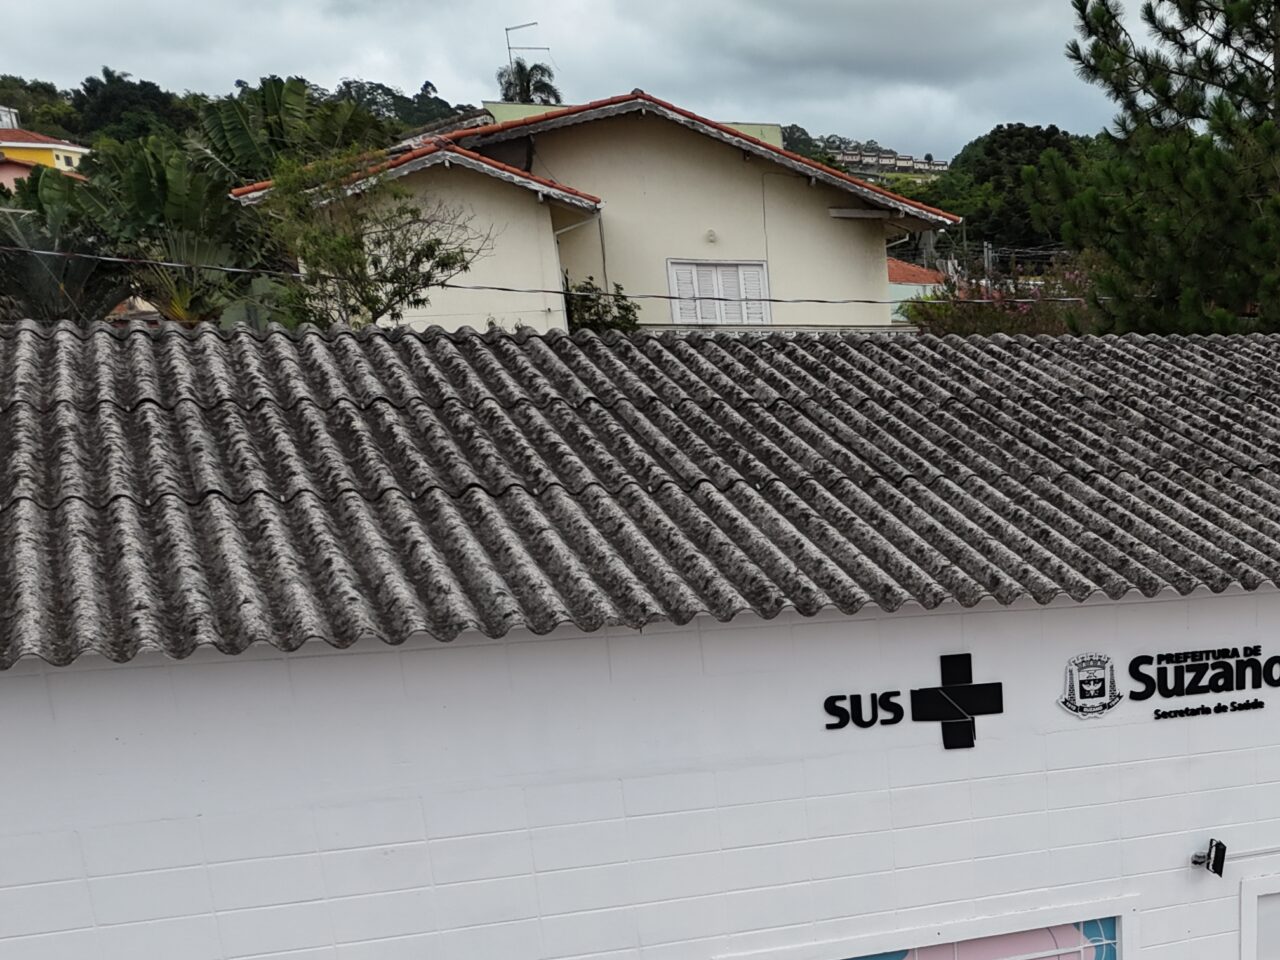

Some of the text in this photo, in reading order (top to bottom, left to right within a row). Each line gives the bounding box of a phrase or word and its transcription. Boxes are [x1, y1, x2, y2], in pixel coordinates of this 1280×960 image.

[1156, 645, 1262, 665] PREFEITURA DE
[823, 689, 905, 731] SUS
[1154, 704, 1212, 720] Secretaria
[1213, 702, 1229, 715] de
